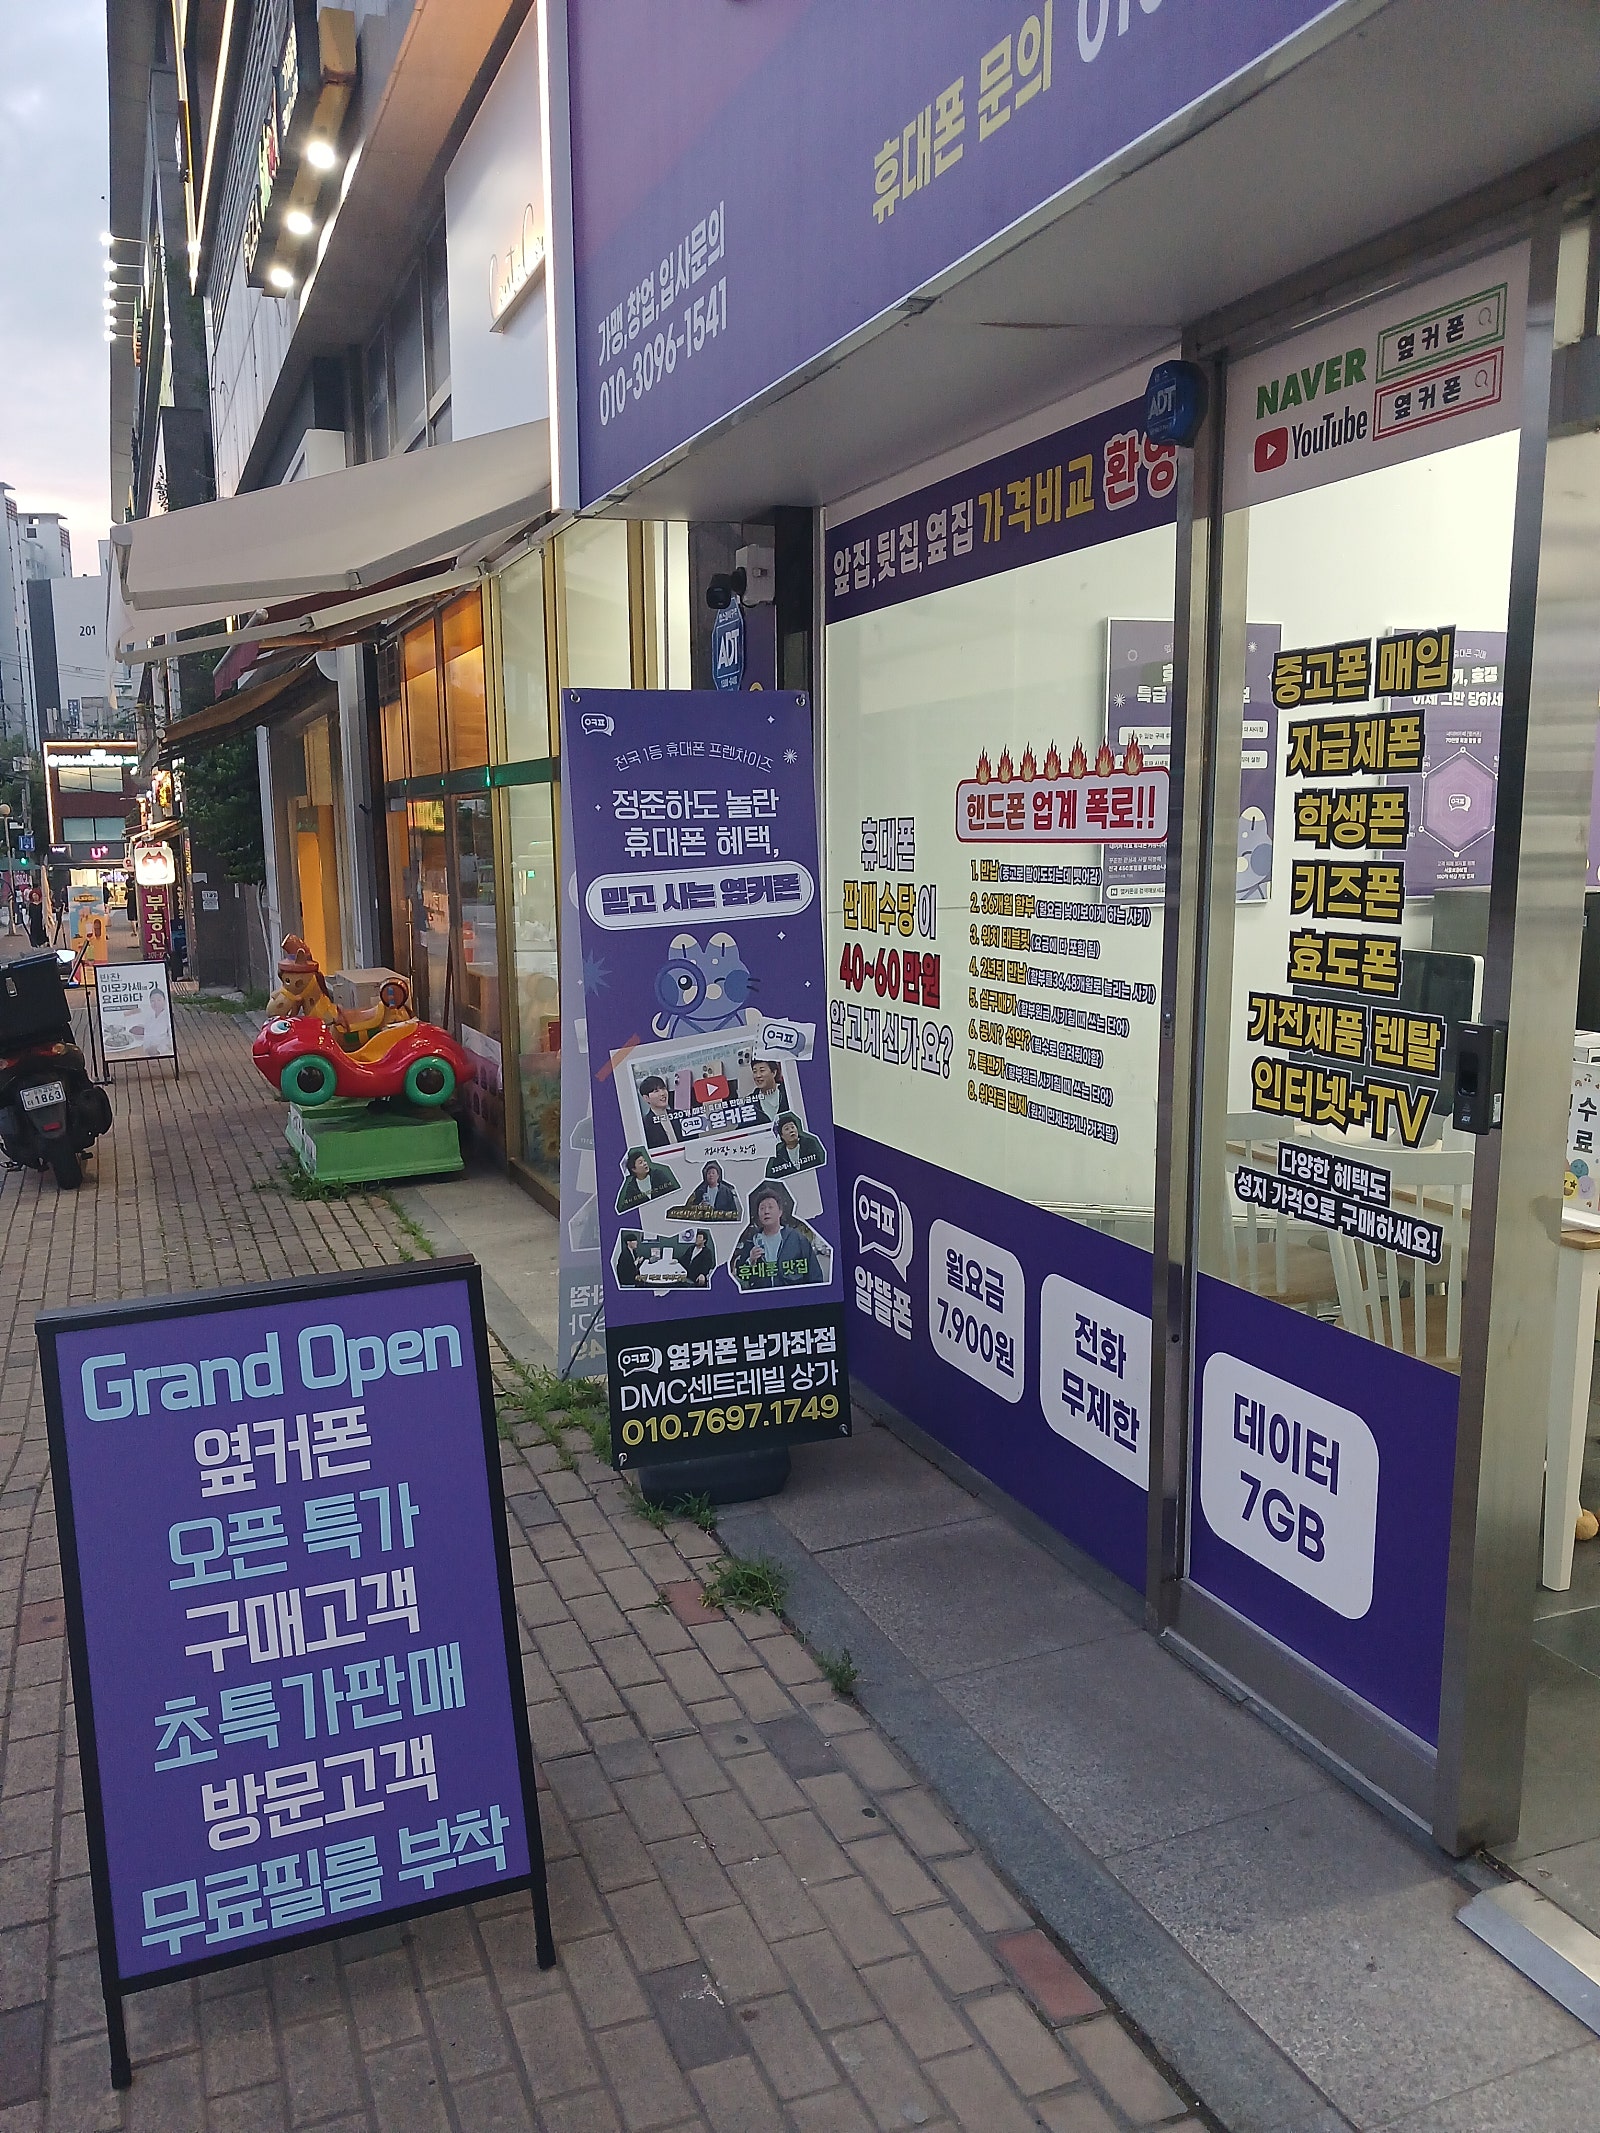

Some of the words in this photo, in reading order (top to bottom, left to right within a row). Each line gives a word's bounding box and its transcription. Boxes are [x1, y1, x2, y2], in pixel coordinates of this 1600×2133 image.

[872, 75, 966, 224] 휴대폰
[977, 0, 1053, 142] 문의
[600, 276, 727, 426] 010-3096-1541
[1147, 384, 1176, 420] ADT
[1256, 347, 1367, 420] NAVER
[1291, 406, 1368, 460] YouTube
[978, 453, 1095, 544] 가격비교
[79, 625, 96, 637] 201
[717, 628, 740, 670] ADT
[1273, 643, 1371, 706] 중고폰
[1377, 632, 1452, 694] 매입
[613, 751, 642, 772] 전국
[643, 744, 663, 761] 1등
[666, 741, 705, 757] 휴대폰
[709, 742, 774, 774] 프렌차이즈
[1288, 714, 1423, 774] 자급제폰
[612, 790, 720, 820] 정준하도
[726, 788, 779, 819] 놀란
[967, 791, 1026, 831] 핸드폰
[1032, 789, 1078, 831] 업계
[1085, 785, 1156, 830] 폭로!!
[1296, 791, 1406, 845] 학생폰
[624, 827, 706, 857] 휴대폰
[716, 825, 779, 858] 혜택,
[861, 817, 915, 872] 휴대폰
[145, 894, 167, 950] 부동산
[601, 884, 657, 917] 믿고
[663, 882, 717, 912] 사는
[719, 872, 803, 907] 옆커폰
[843, 880, 936, 940] 판매수당이
[981, 892, 1013, 917] 36개월
[1292, 864, 1403, 920] 키즈폰
[1289, 932, 1400, 994] 효도폰
[102, 993, 143, 1005] 요리하다
[830, 999, 954, 1080] 알고계신가요?
[1248, 995, 1366, 1059] 가전제품
[1372, 1011, 1443, 1073] 렌탈
[35, 1091, 62, 1104] 1863
[709, 1105, 757, 1129] 옆커폰
[1252, 1060, 1431, 1144] 인터넷+TV
[1281, 1147, 1330, 1185] 다양한
[1333, 1160, 1388, 1201] 혜택도
[1236, 1170, 1268, 1203] 성지
[1269, 1181, 1337, 1224] 가격으로
[1339, 1202, 1439, 1259] 구매하세요!
[782, 1258, 809, 1276] 맛집
[946, 1248, 1005, 1314] 월요금
[854, 1265, 913, 1341] 알뜰폰
[80, 1331, 284, 1423] Grand
[297, 1323, 463, 1399] Open
[667, 1337, 738, 1371] 옆커폰
[744, 1326, 837, 1361] 남가좌점
[1075, 1312, 1127, 1380] 전화
[620, 1368, 785, 1411] DMC센트레빌
[790, 1360, 839, 1390] 상가
[1061, 1368, 1140, 1454] 무제한
[622, 1394, 839, 1446] 010.7697.1749
[1233, 1391, 1341, 1497] 데이터
[193, 1405, 372, 1499] 옆커폰
[168, 1505, 290, 1592] 오픈
[302, 1481, 420, 1560] 특가
[1240, 1469, 1326, 1563] 7GB
[184, 1565, 421, 1674] 구매고객
[153, 1641, 467, 1773] 초특가판매
[200, 1733, 440, 1852] 방문고객
[141, 1834, 384, 1956] 무료필름
[397, 1803, 511, 1890] 부착
